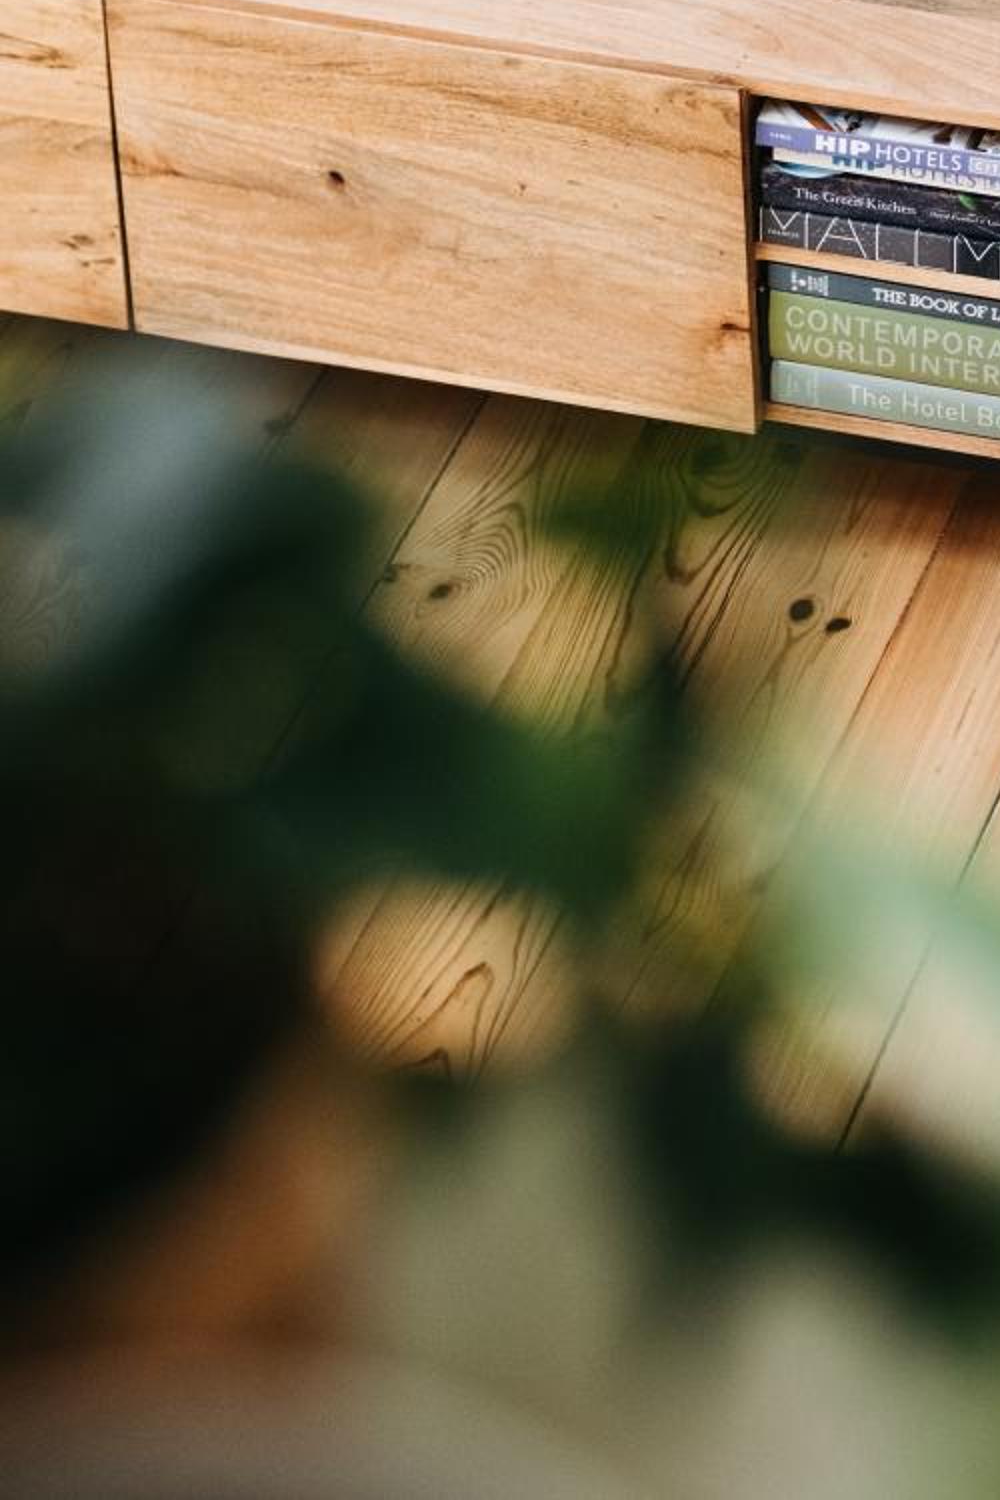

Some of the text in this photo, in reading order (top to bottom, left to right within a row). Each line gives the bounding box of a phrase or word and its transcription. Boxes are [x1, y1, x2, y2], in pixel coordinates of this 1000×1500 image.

[815, 133, 871, 156] HIP
[875, 143, 962, 171] HOTELS
[793, 187, 917, 215] The Green Kitchen
[872, 286, 907, 305] THE
[910, 293, 960, 315] BOOK
[963, 303, 989, 319] OF
[785, 331, 896, 367] WORLD
[848, 382, 891, 411] The
[902, 389, 968, 423] Hotel
